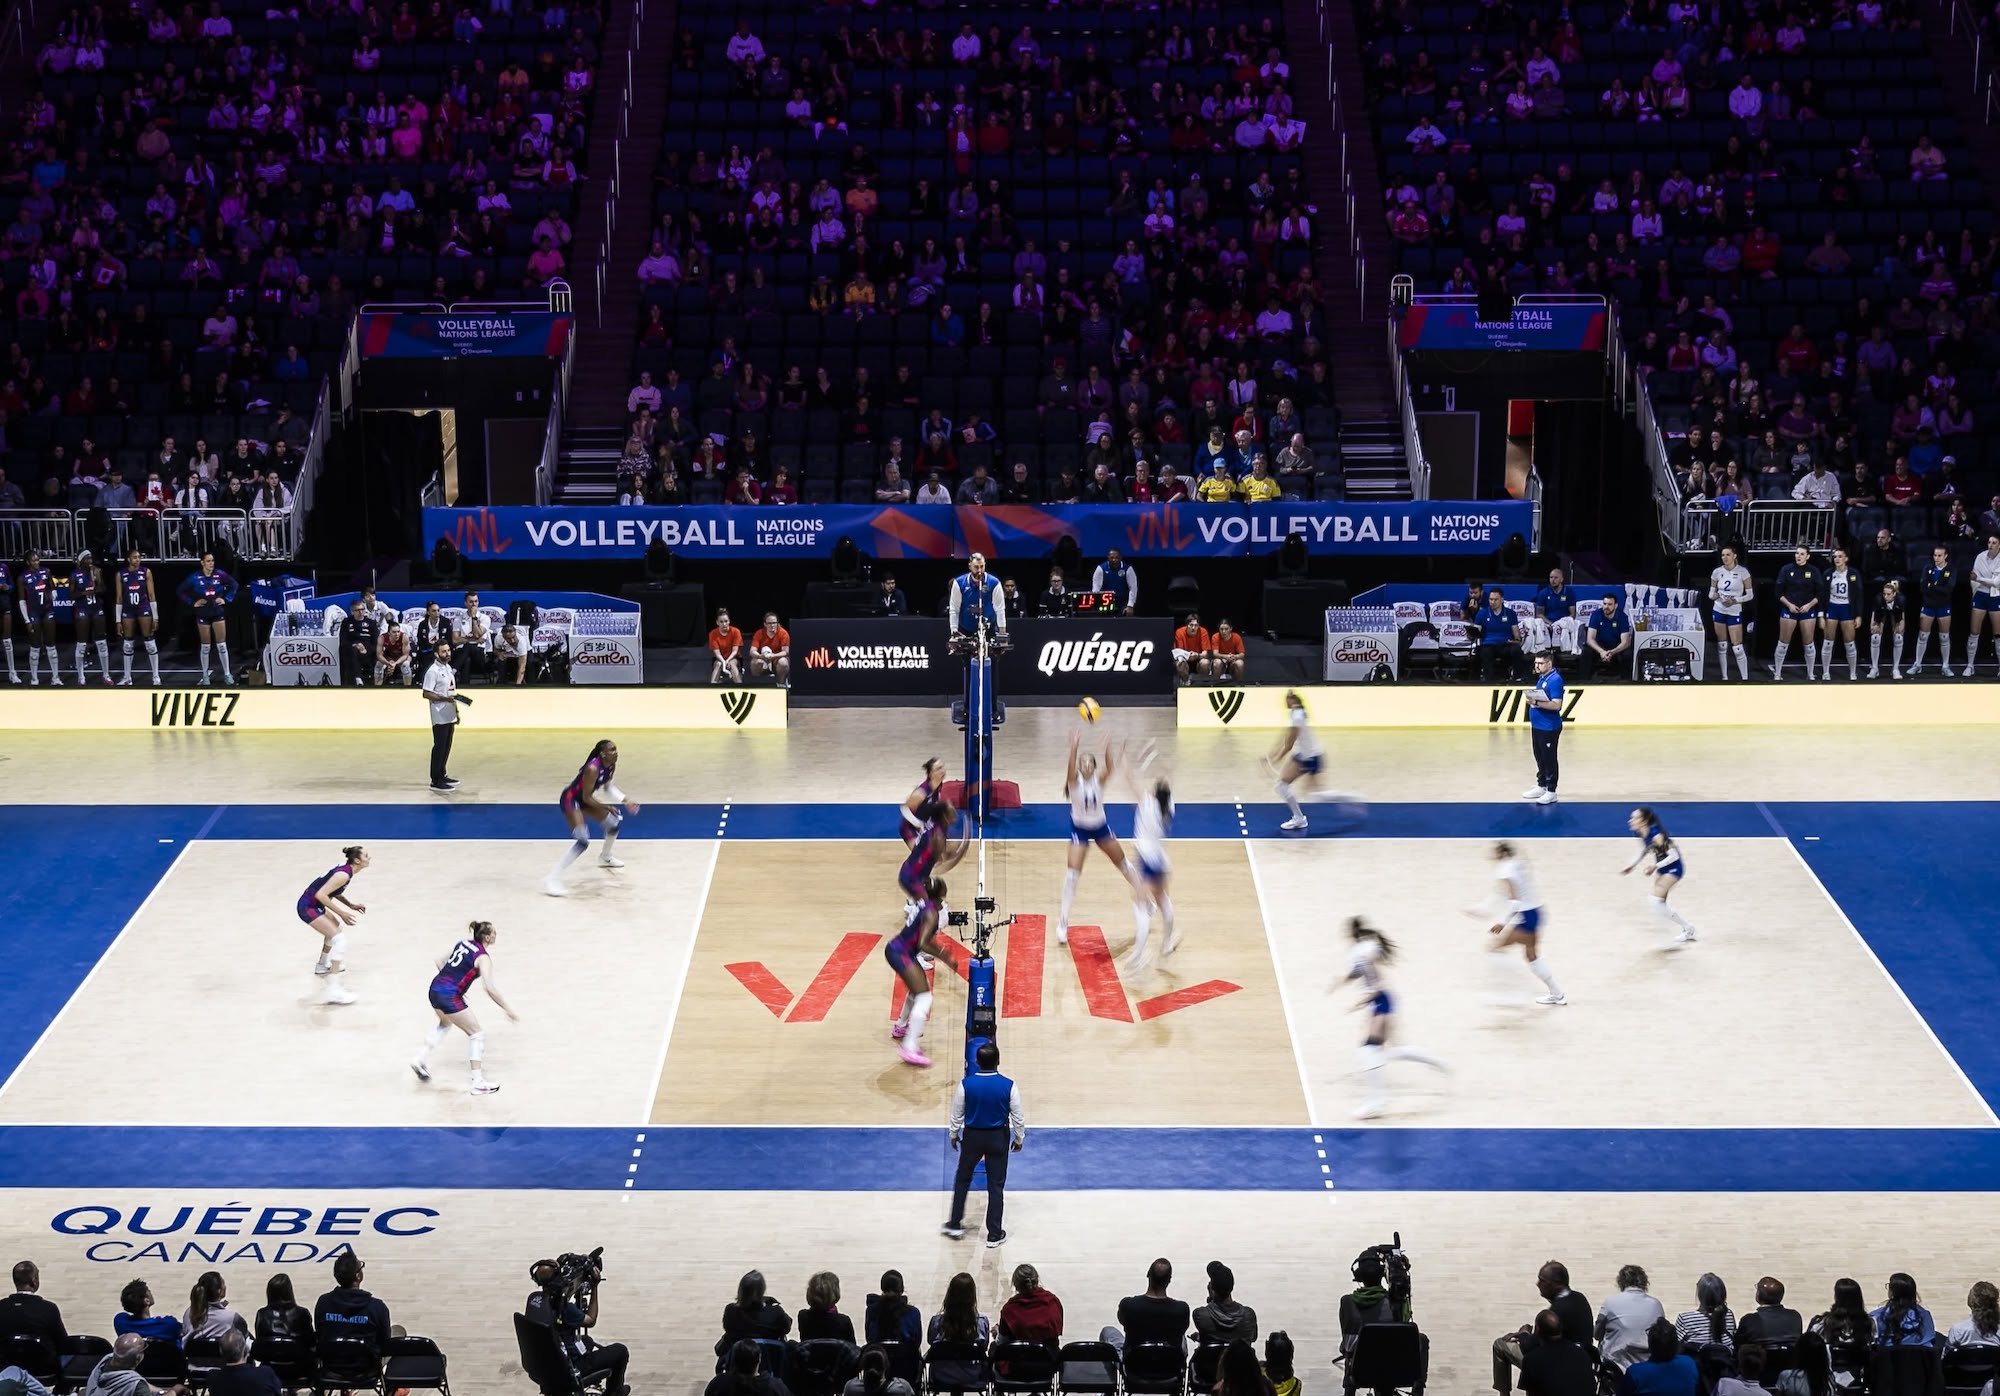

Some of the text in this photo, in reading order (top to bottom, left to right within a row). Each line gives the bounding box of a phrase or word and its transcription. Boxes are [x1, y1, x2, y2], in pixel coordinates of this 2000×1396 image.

[1475, 310, 1553, 320] YBALL
[438, 320, 516, 330] VOLLEYBALL
[1474, 321, 1553, 330] NATIONS LEAGUE
[439, 330, 516, 339] NATIONS LEAGUE
[757, 519, 824, 532] NATIONS
[1431, 515, 1500, 527] NATIONS
[445, 508, 511, 553] VNL
[525, 519, 745, 546] VOLLEYBALL
[1126, 504, 1194, 552] VNL
[1197, 516, 1418, 543] VOLLEYBALL
[757, 533, 816, 546] LEAGUE
[1431, 529, 1490, 541] LEAGUE
[1723, 580, 1731, 592] 2
[1835, 582, 1847, 594] 13
[38, 591, 44, 605] 7
[129, 592, 140, 605] 10
[285, 643, 319, 653] 百岁山
[584, 642, 618, 652] 百岁山
[1343, 639, 1377, 650] 百岁山
[1648, 638, 1684, 648] 百岁山
[805, 647, 835, 668] VNL
[837, 646, 929, 660] VOLLEYBALL
[1037, 632, 1154, 677] QUÉBEC
[838, 660, 929, 669] NATIONS LEAGUE
[151, 693, 240, 726] VIVEZ
[1489, 689, 1584, 722] VIZ
[724, 914, 1243, 1023] VNL
[51, 1202, 440, 1235] QUÉBEC
[86, 1241, 355, 1263] CANADA
